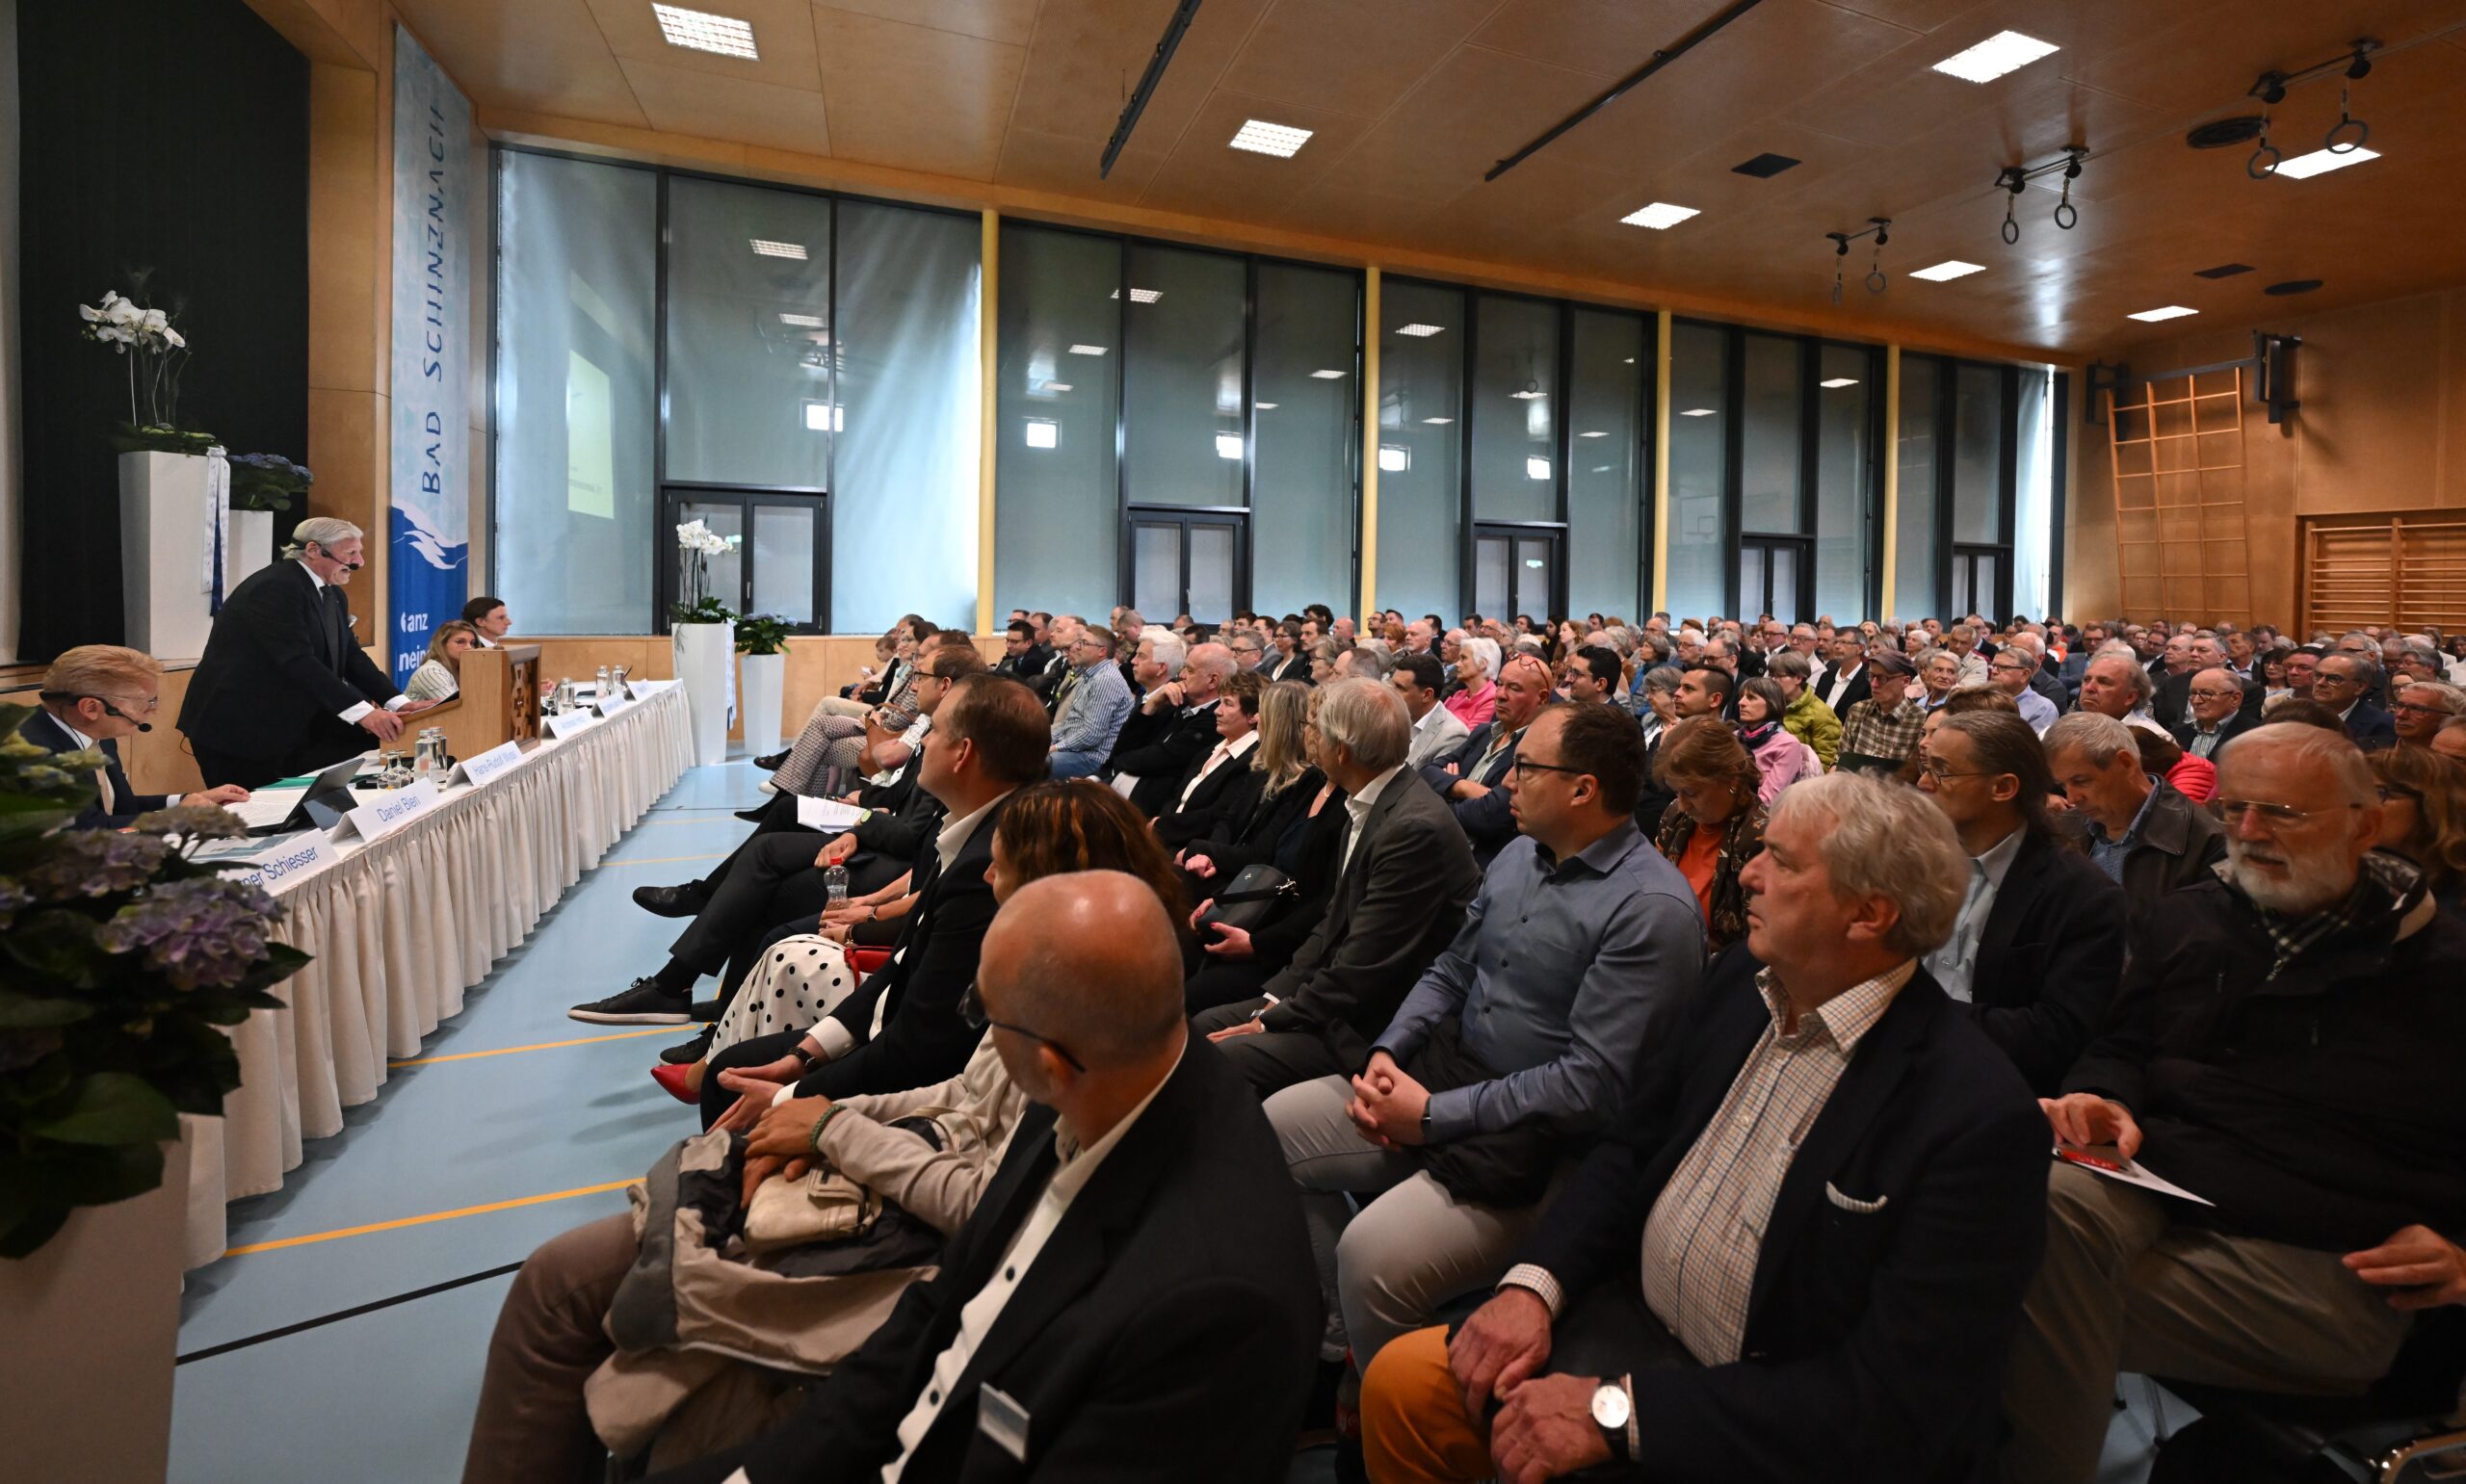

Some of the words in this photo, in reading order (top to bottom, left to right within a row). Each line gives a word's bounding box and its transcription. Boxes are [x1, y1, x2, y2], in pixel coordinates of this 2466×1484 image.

[423, 105, 445, 382] SCHINZNACH
[421, 411, 441, 495] BAD
[377, 800, 404, 822] Daniel
[261, 846, 319, 880] Schiesser
